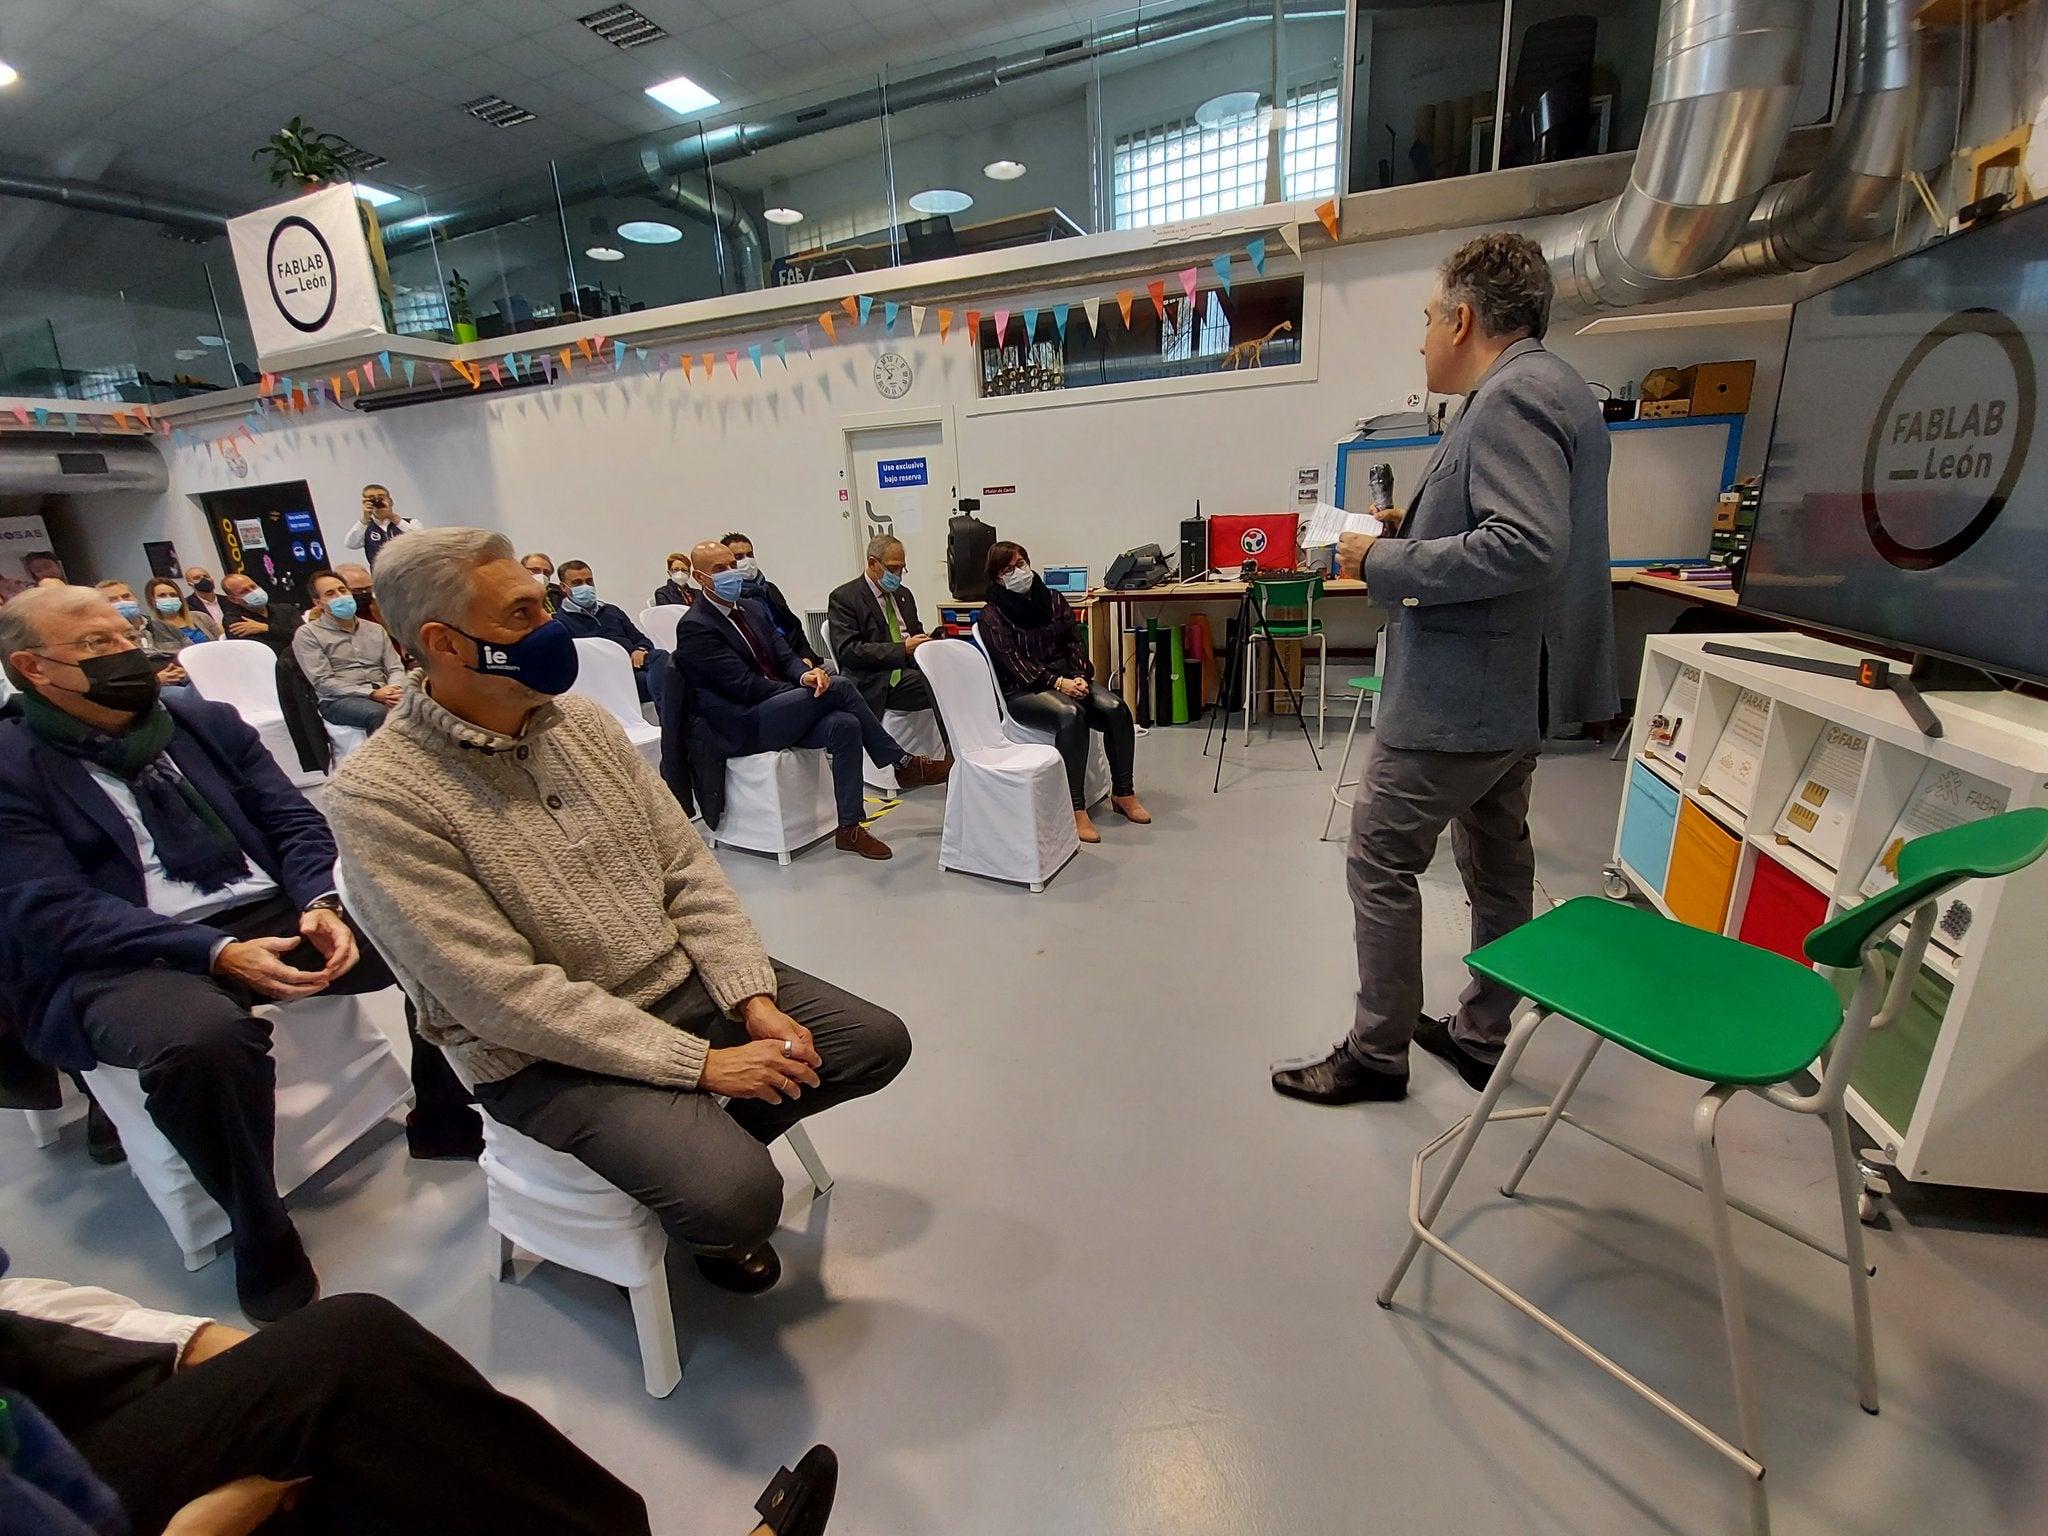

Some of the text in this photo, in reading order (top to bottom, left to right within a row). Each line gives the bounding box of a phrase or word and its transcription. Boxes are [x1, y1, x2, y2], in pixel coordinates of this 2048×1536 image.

[277, 254, 324, 279] FABLAB
[1892, 400, 2006, 445] FABLAB
[895, 461, 924, 471] exclusivo
[884, 473, 922, 484] bajo reserva
[0, 529, 42, 540] OSAS
[483, 645, 508, 665] ie
